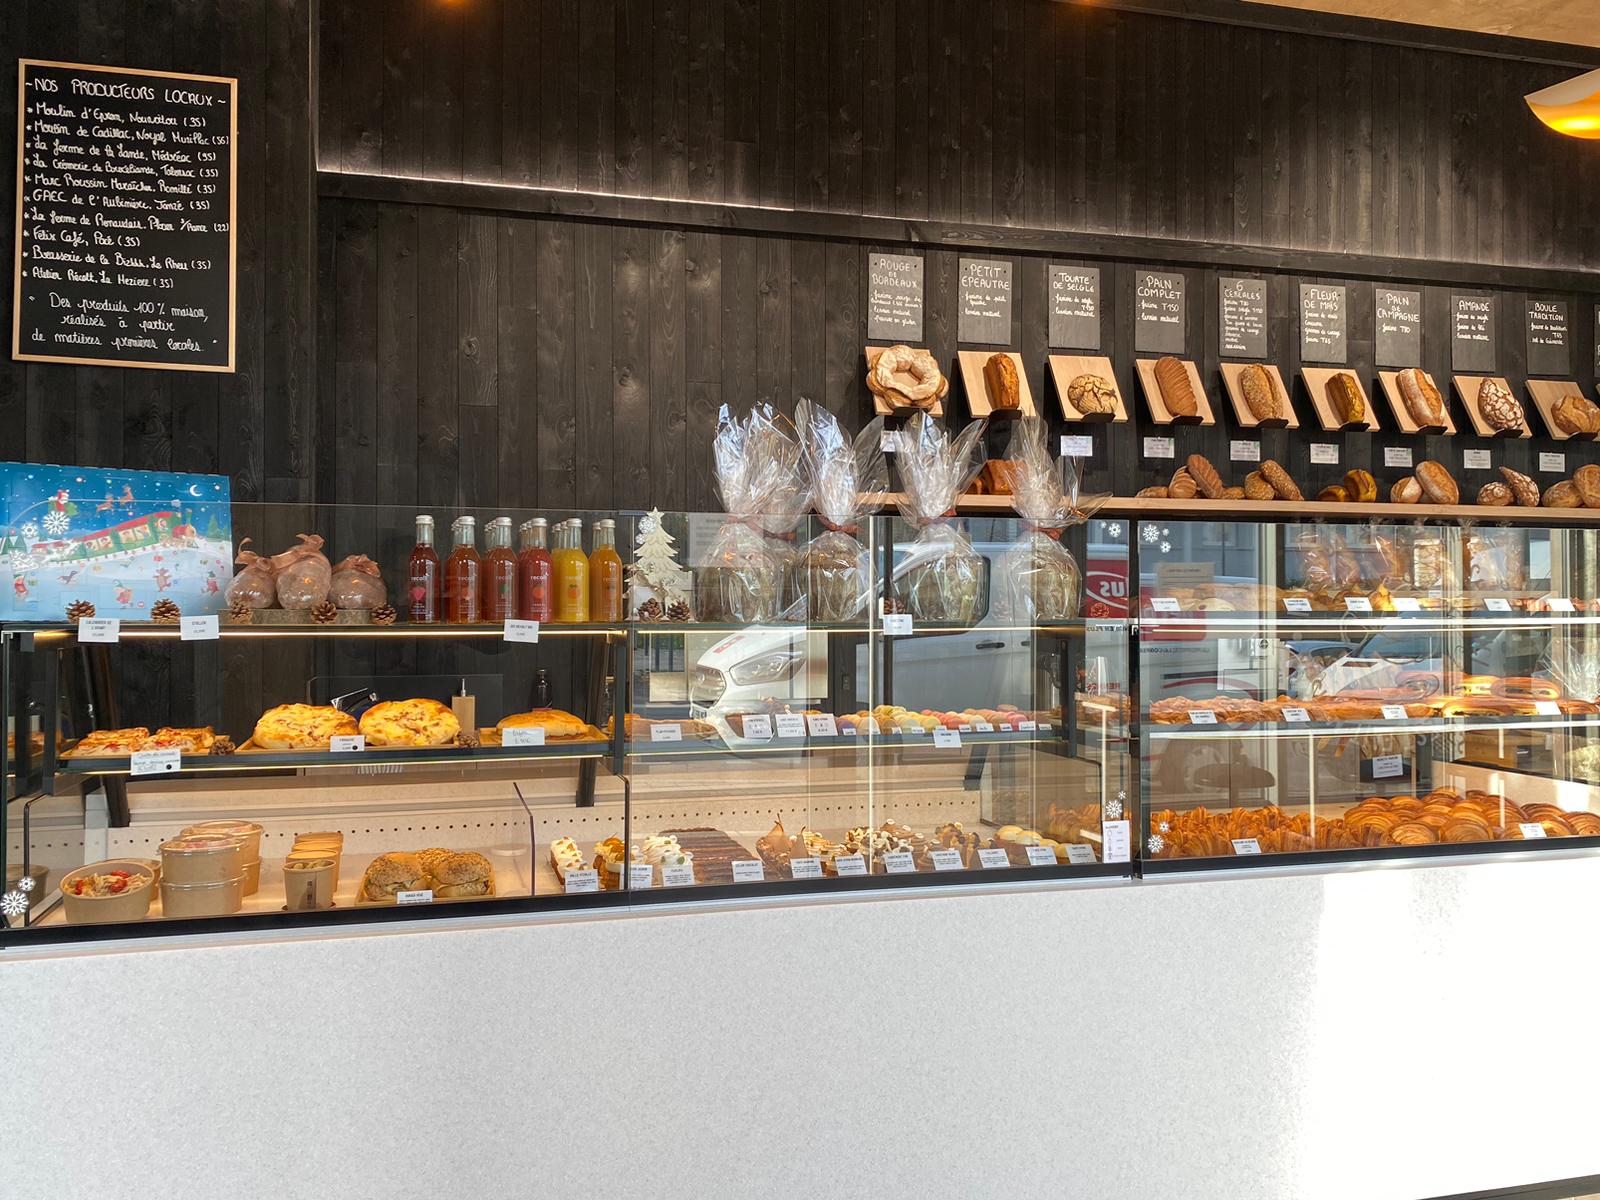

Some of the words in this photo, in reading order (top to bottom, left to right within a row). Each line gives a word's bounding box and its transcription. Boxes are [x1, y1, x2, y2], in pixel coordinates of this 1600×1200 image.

[34, 78, 58, 93] NOS
[71, 78, 155, 100] PRODUCTEURS
[165, 89, 212, 107] LOCAUX
[36, 101, 76, 118] Moulin
[77, 126, 90, 138] de
[33, 134, 48, 150] La
[90, 144, 101, 156] de
[33, 153, 48, 168] La
[93, 163, 103, 172] de
[33, 188, 68, 203] GAEC
[72, 193, 84, 205] de
[81, 214, 92, 226] de
[85, 252, 97, 264] de
[879, 258, 911, 272] ROUGE
[970, 263, 1002, 278] PETIT
[871, 273, 918, 289] BORDEAUX
[961, 275, 1010, 291] EPEAUTRE
[1053, 281, 1064, 290] DE
[1058, 272, 1090, 285] TOURTE
[1146, 275, 1172, 290] PAIN
[1137, 286, 1182, 300] COMPLET
[1235, 280, 1244, 292] 6
[1310, 288, 1339, 302] FLEUR
[1385, 293, 1410, 306] PAIN
[49, 292, 72, 308] Des
[77, 298, 130, 314] produits
[133, 301, 155, 314] 100
[1304, 299, 1316, 309] DE
[1458, 300, 1490, 312] AMANDE
[1534, 302, 1558, 313] BOULE
[1377, 307, 1421, 323] CAMPAGNE
[61, 314, 107, 327] réalisés
[138, 318, 176, 333] partir
[31, 327, 47, 342] de
[54, 332, 103, 346] matières
